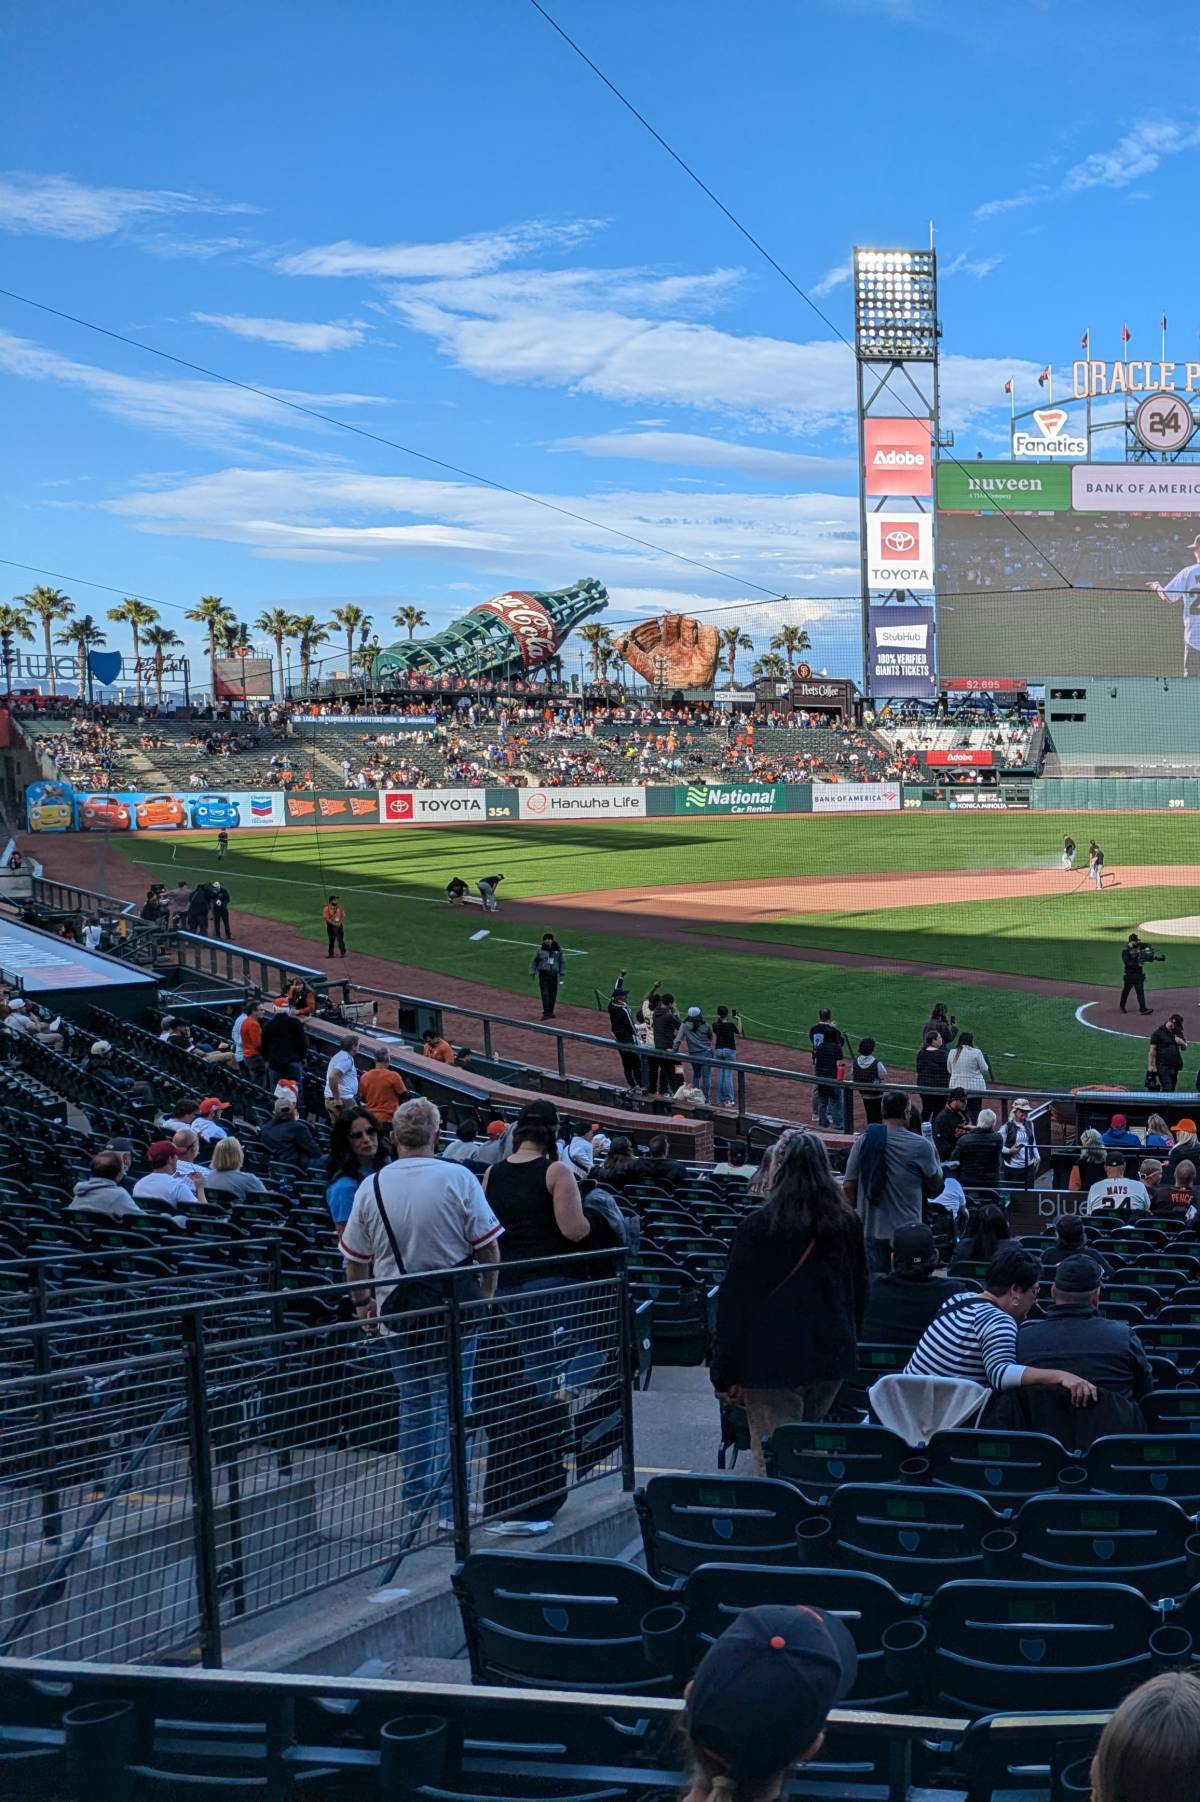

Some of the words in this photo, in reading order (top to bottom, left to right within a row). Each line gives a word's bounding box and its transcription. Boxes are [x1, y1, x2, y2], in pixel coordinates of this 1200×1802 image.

[1072, 360, 1175, 399] ORACLE
[1150, 404, 1181, 437] 24
[1016, 436, 1085, 452] Fanatics
[873, 450, 925, 465] Adobe
[968, 478, 1042, 491] nuveen
[1086, 483, 1124, 493] BANK
[1128, 484, 1144, 493] OF
[872, 569, 929, 580] TOYOTA
[882, 632, 920, 641] StubHub
[877, 654, 896, 664] 100%
[898, 654, 926, 664] VERIFIED
[876, 666, 900, 676] GIANTS
[902, 666, 929, 675] TICKETS
[819, 685, 839, 697] Coffee
[551, 797, 609, 809] Hanwha
[613, 797, 639, 808] Life
[708, 789, 776, 805] National
[419, 799, 481, 812] TOYOTA
[750, 805, 772, 813] Rental
[903, 800, 921, 808] 399
[1169, 799, 1185, 808] 391
[488, 807, 510, 817] 354
[1107, 1186, 1128, 1195] MAYS
[1038, 1193, 1088, 1216] blue
[1171, 1193, 1194, 1205] PENCE
